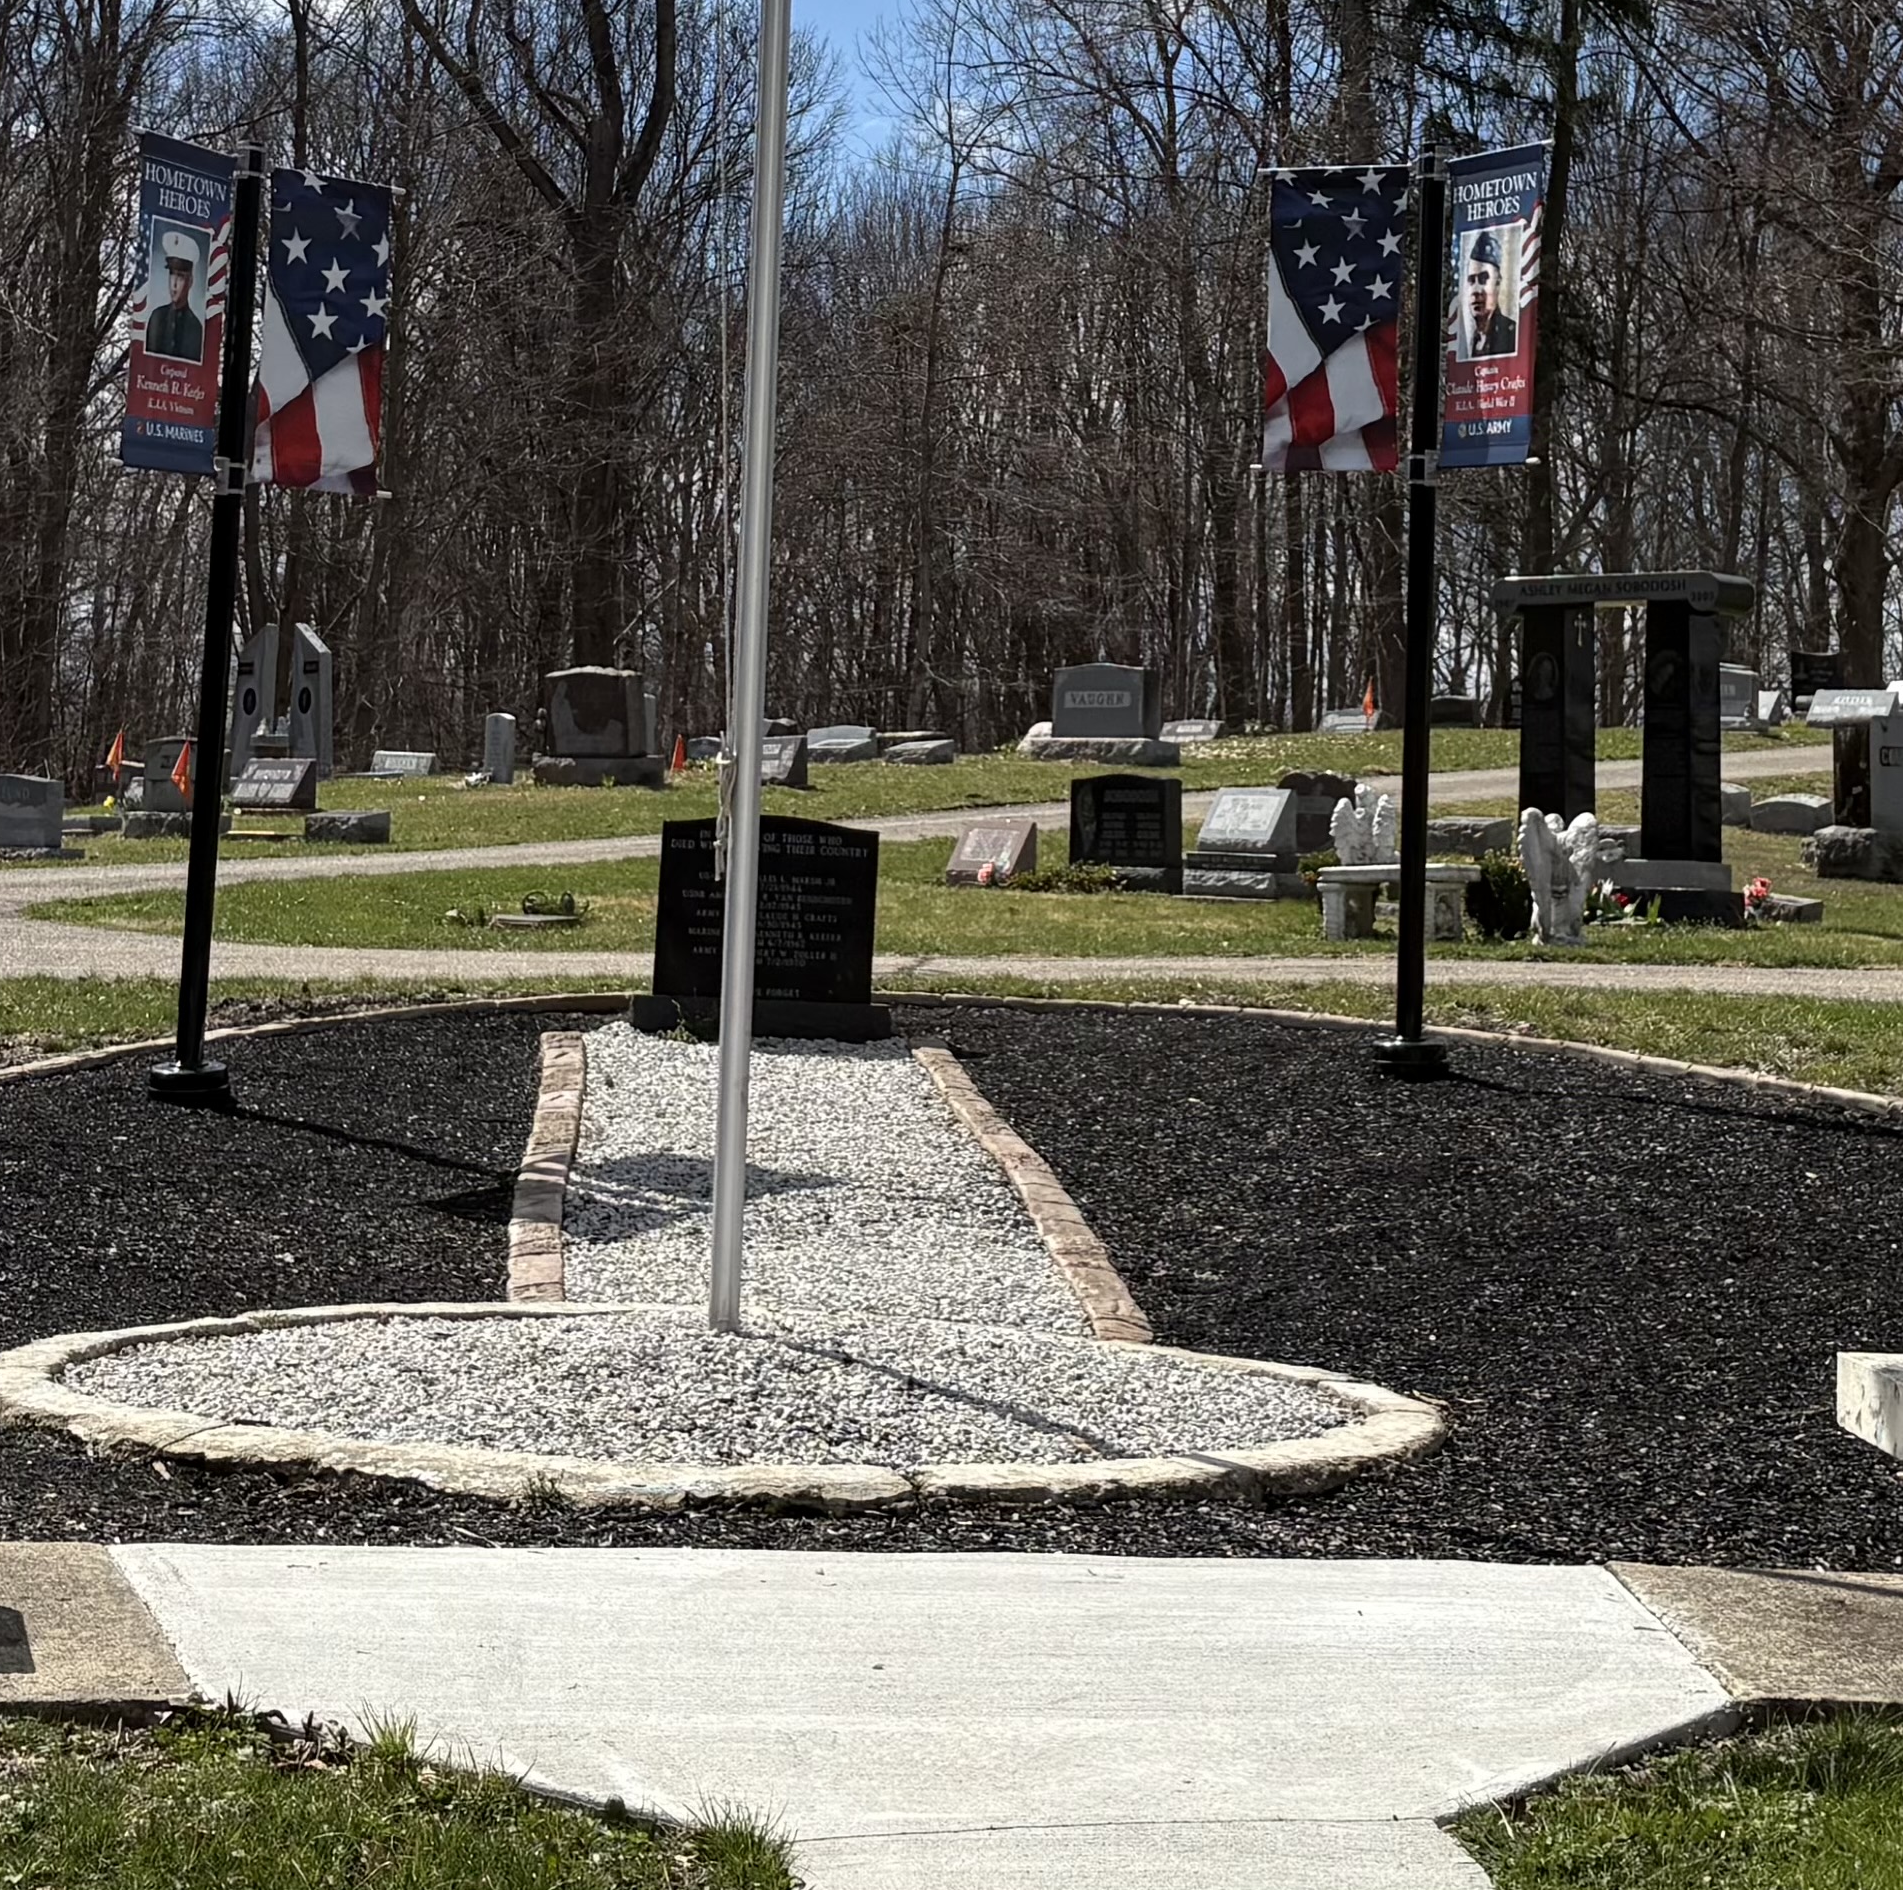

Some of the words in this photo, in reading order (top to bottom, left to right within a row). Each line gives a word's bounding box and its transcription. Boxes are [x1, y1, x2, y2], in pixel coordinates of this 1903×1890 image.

[145, 162, 227, 202] HOMETOWN
[1453, 171, 1538, 205] HOMETOWN
[159, 188, 211, 219] HEROES
[1467, 195, 1521, 222] HEROES
[146, 421, 164, 437] U.S.
[165, 424, 204, 444] MARINES
[1485, 418, 1512, 435] ARMY
[1520, 584, 1563, 597] ASHLEY
[1567, 582, 1612, 595] MEGAN
[1070, 693, 1125, 705] VAUGHN
[762, 832, 775, 843] OF
[782, 833, 813, 845] THOSE
[818, 835, 843, 847] WHO
[786, 844, 816, 855] THEIR
[819, 846, 868, 858] COUNTRY
